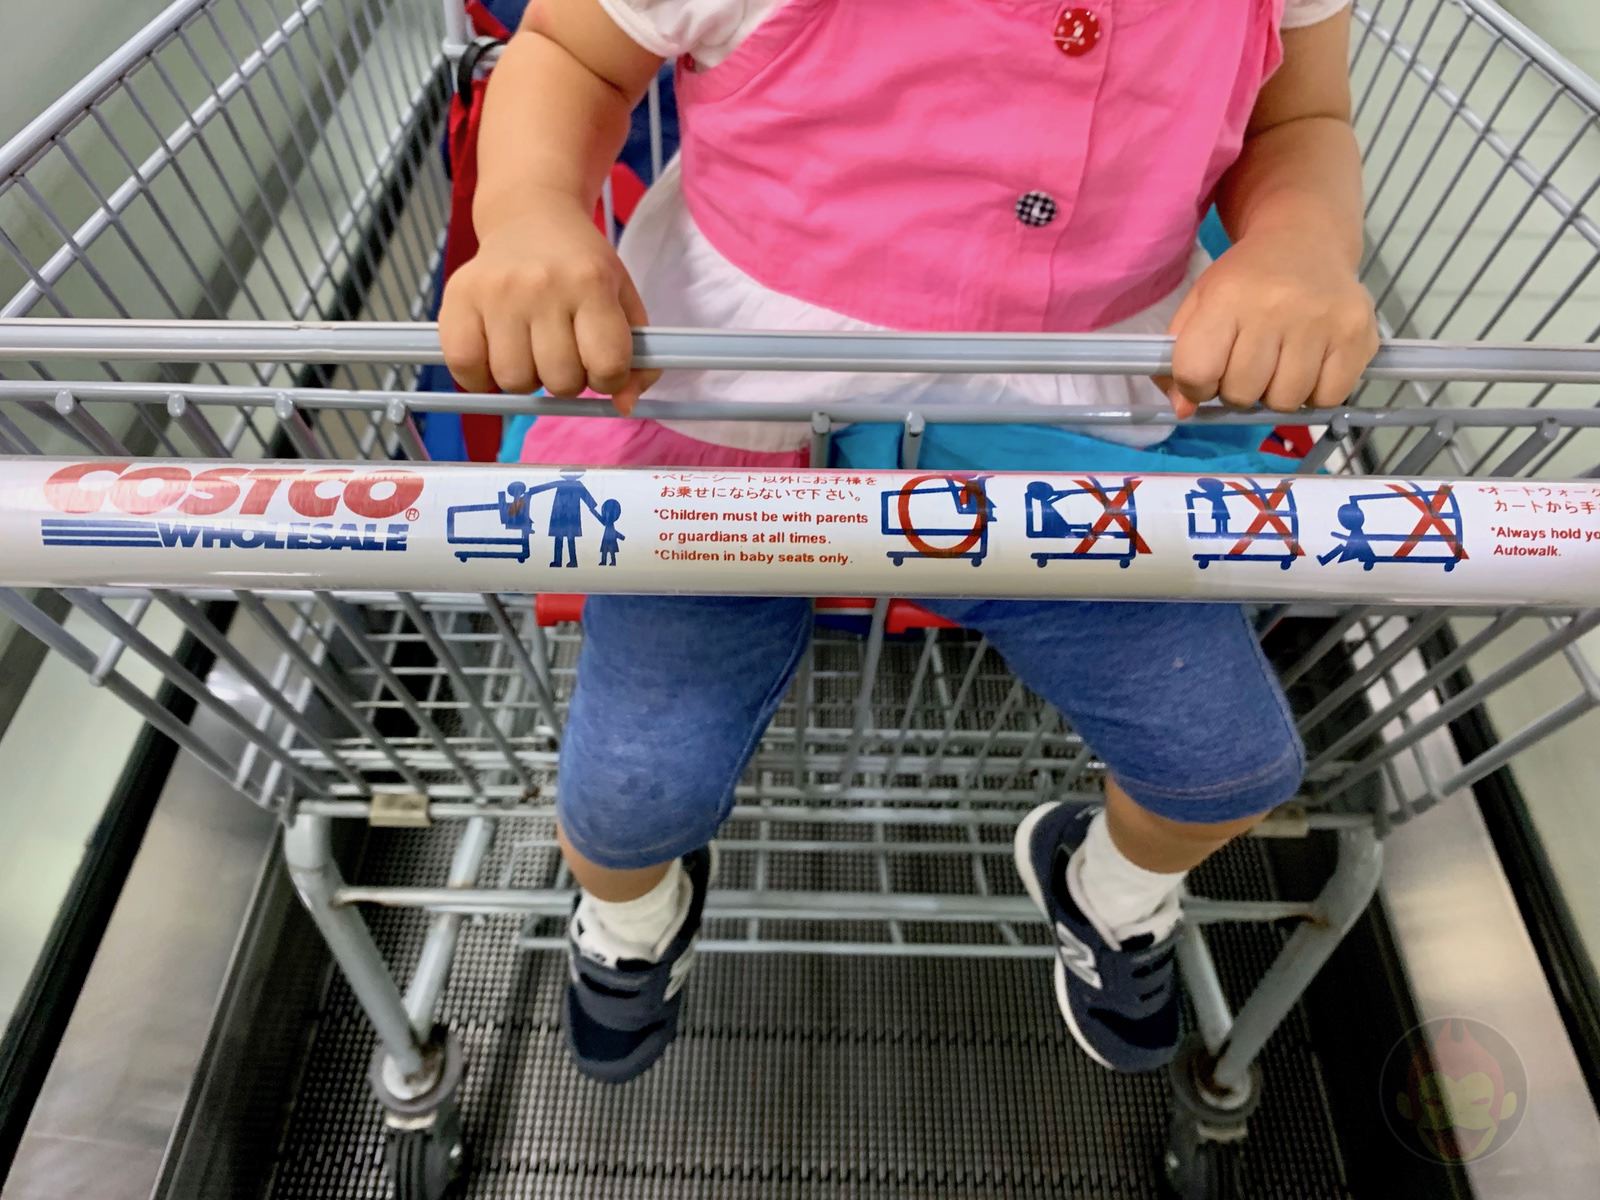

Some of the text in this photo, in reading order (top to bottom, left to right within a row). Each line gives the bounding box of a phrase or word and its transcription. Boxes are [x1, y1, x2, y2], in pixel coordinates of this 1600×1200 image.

[660, 486, 861, 501] お乗せにならないで下さい。
[1494, 500, 1600, 514] カートから手
[722, 511, 758, 522] must
[761, 511, 778, 522] be
[782, 512, 812, 523] with
[816, 513, 868, 525] parents
[156, 520, 409, 552] WHOLESALE
[659, 530, 831, 544] or guardians at all times.
[1551, 528, 1581, 539] hold
[1493, 545, 1562, 557] Autowalk.
[723, 551, 735, 562] in
[739, 551, 774, 564] baby
[778, 553, 815, 563] seats
[819, 553, 853, 566] only.
